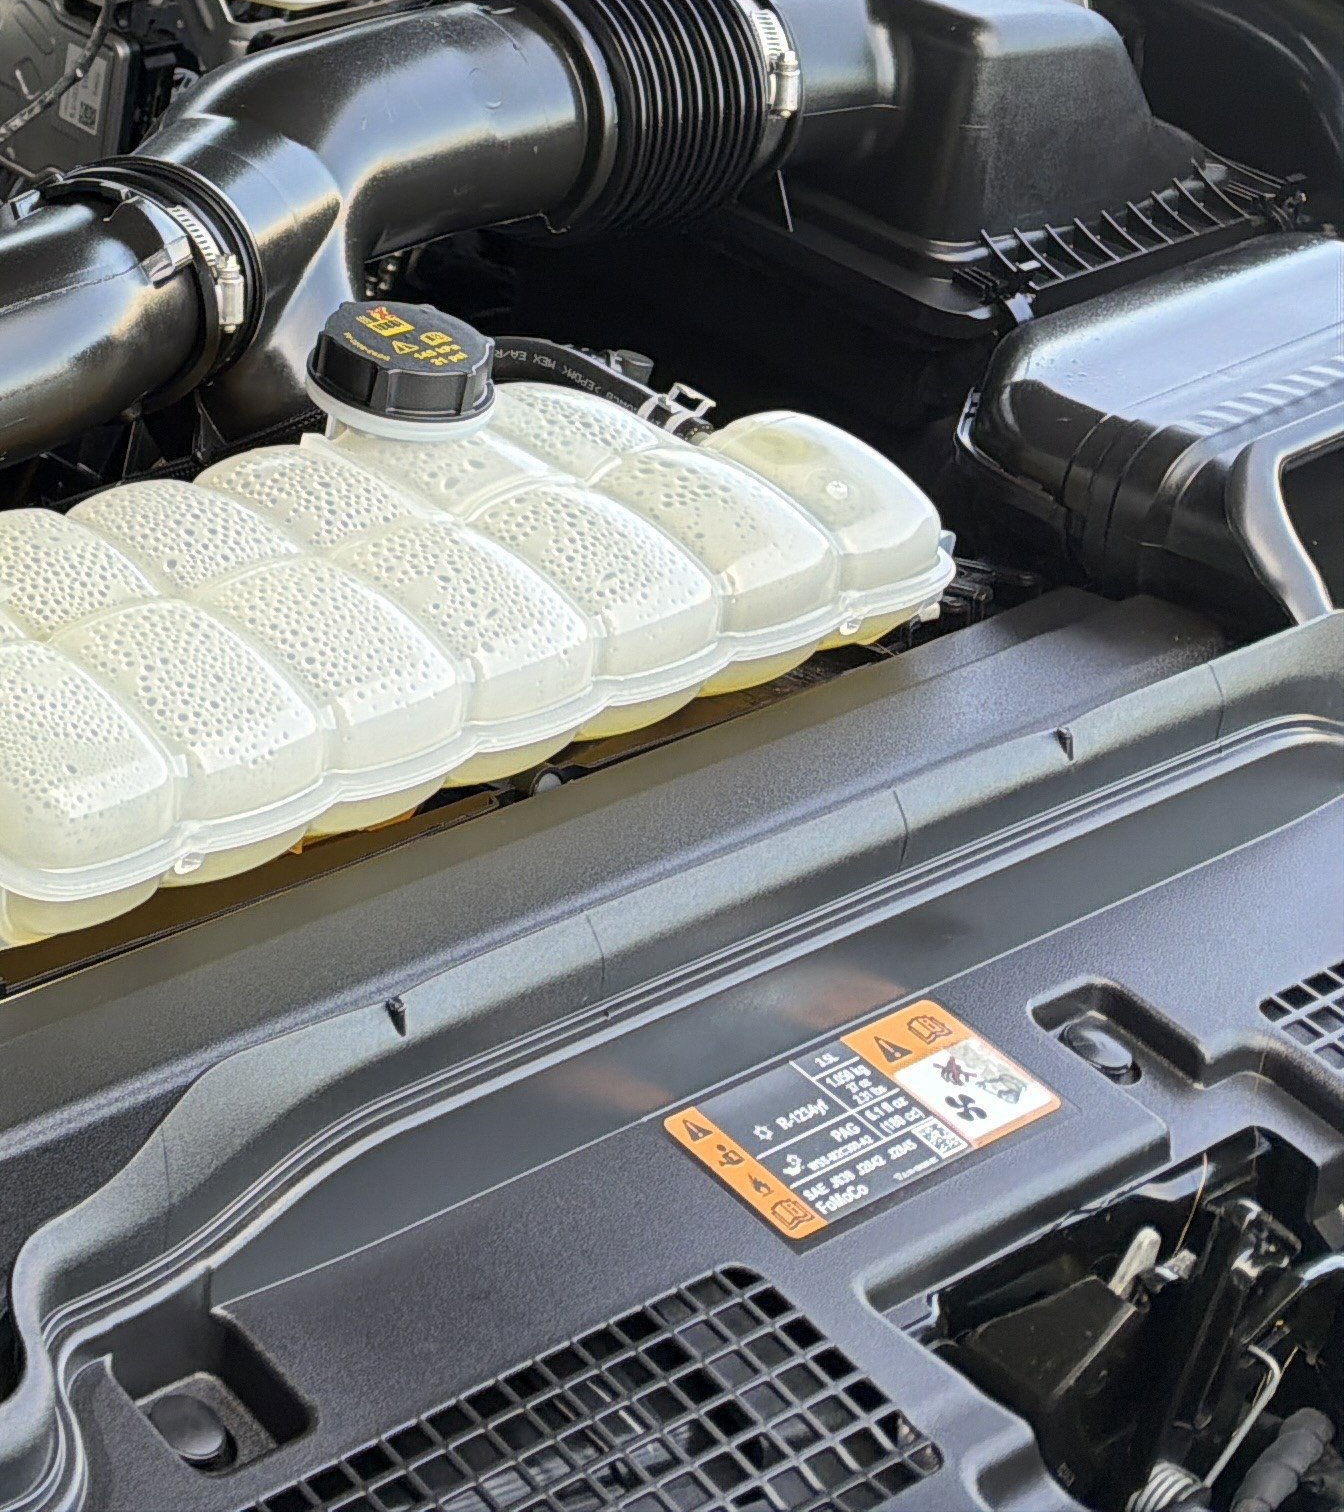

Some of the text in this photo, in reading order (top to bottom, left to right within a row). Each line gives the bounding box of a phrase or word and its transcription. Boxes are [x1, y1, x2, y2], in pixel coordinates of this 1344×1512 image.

[851, 1064, 870, 1080] kg
[830, 1122, 861, 1141] PAG
[802, 1183, 829, 1199] SAE
[815, 1184, 870, 1214] FoMoCo
